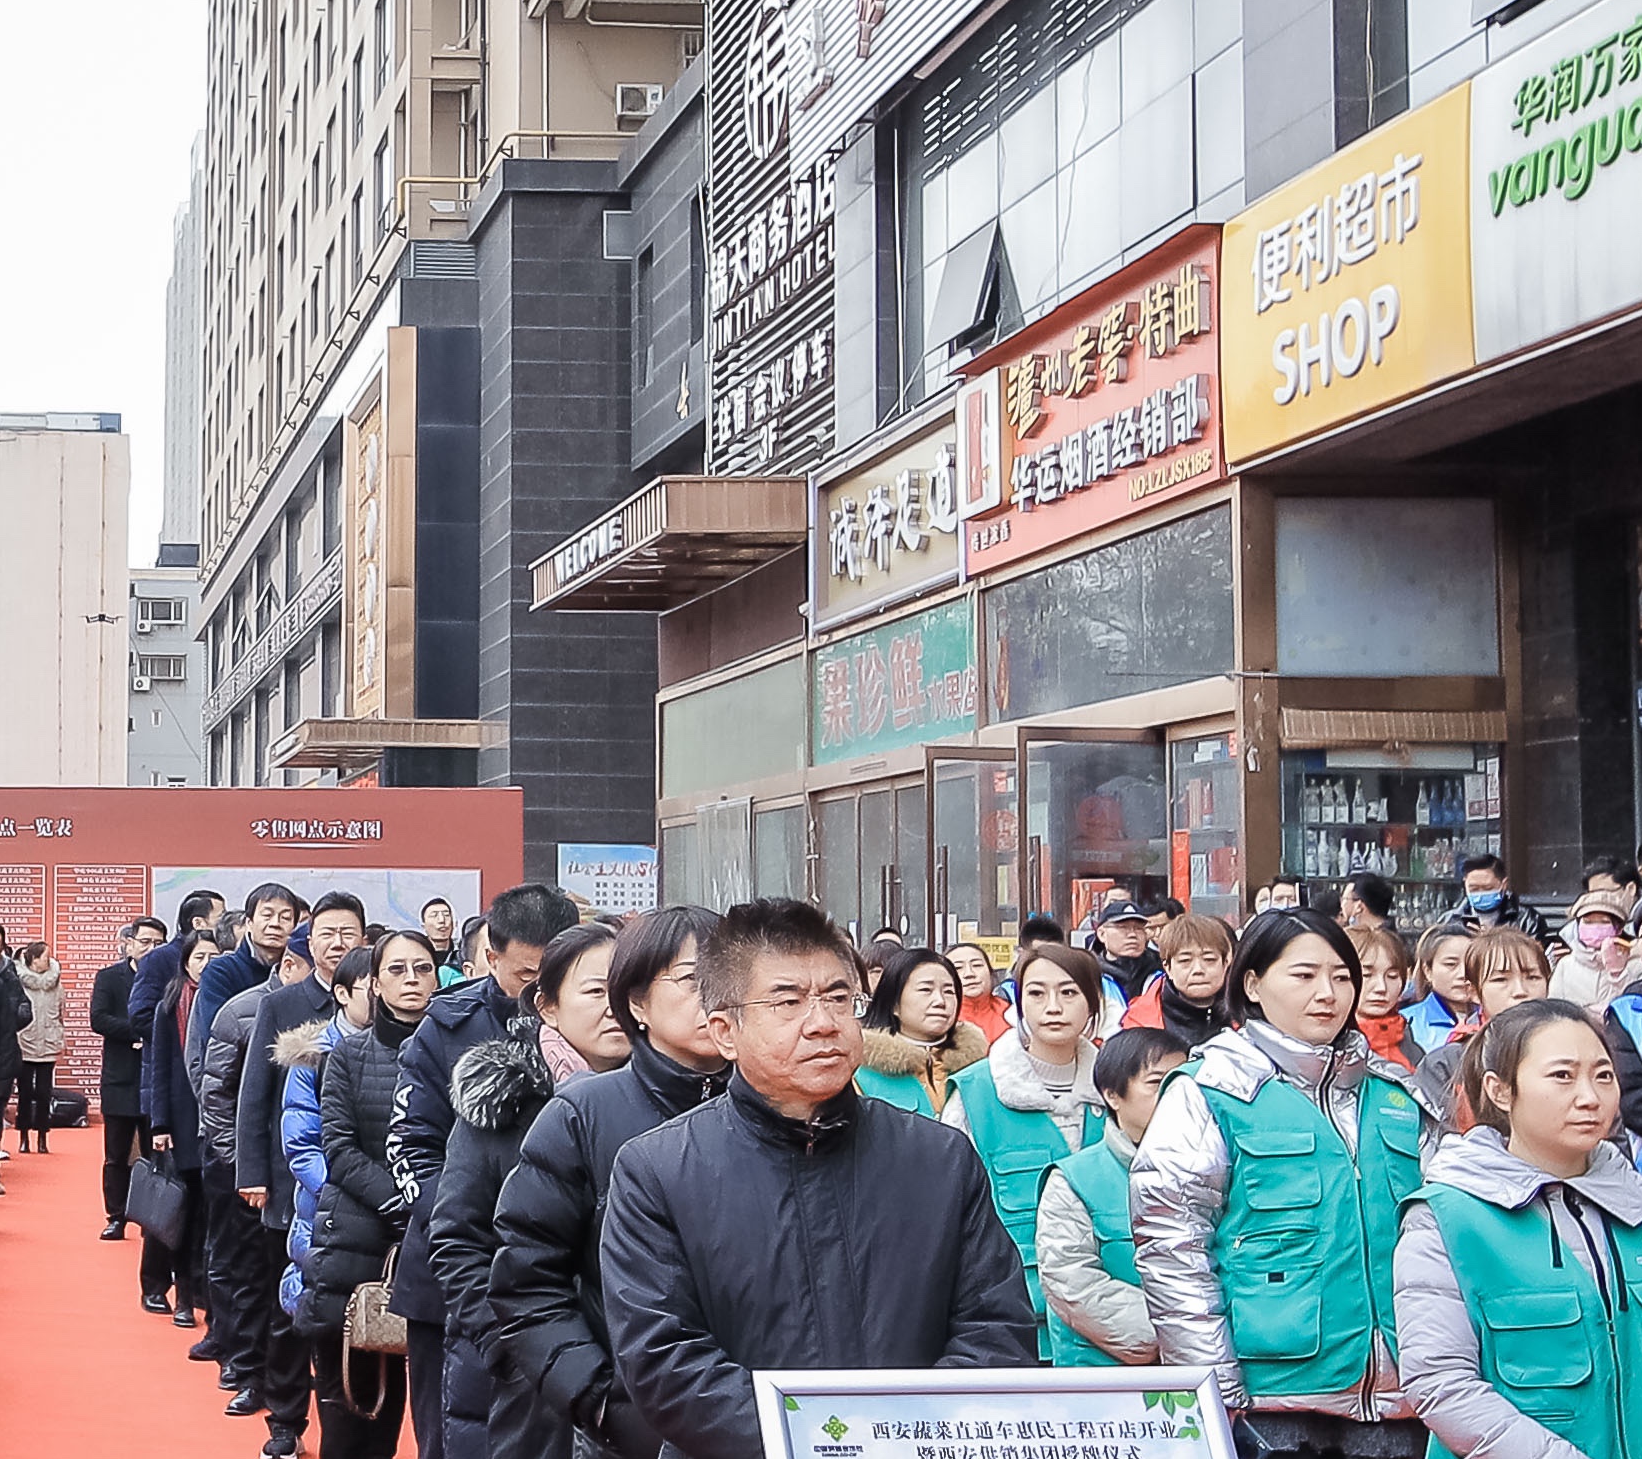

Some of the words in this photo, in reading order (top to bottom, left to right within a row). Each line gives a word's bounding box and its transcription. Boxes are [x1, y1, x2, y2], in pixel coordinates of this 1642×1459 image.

[780, 224, 836, 303] HOTEL
[1249, 152, 1424, 315] 便利超市
[1270, 284, 1400, 407] SHOP
[1010, 376, 1200, 513] 华运烟酒经销部
[251, 819, 384, 841] 零售网点示意图
